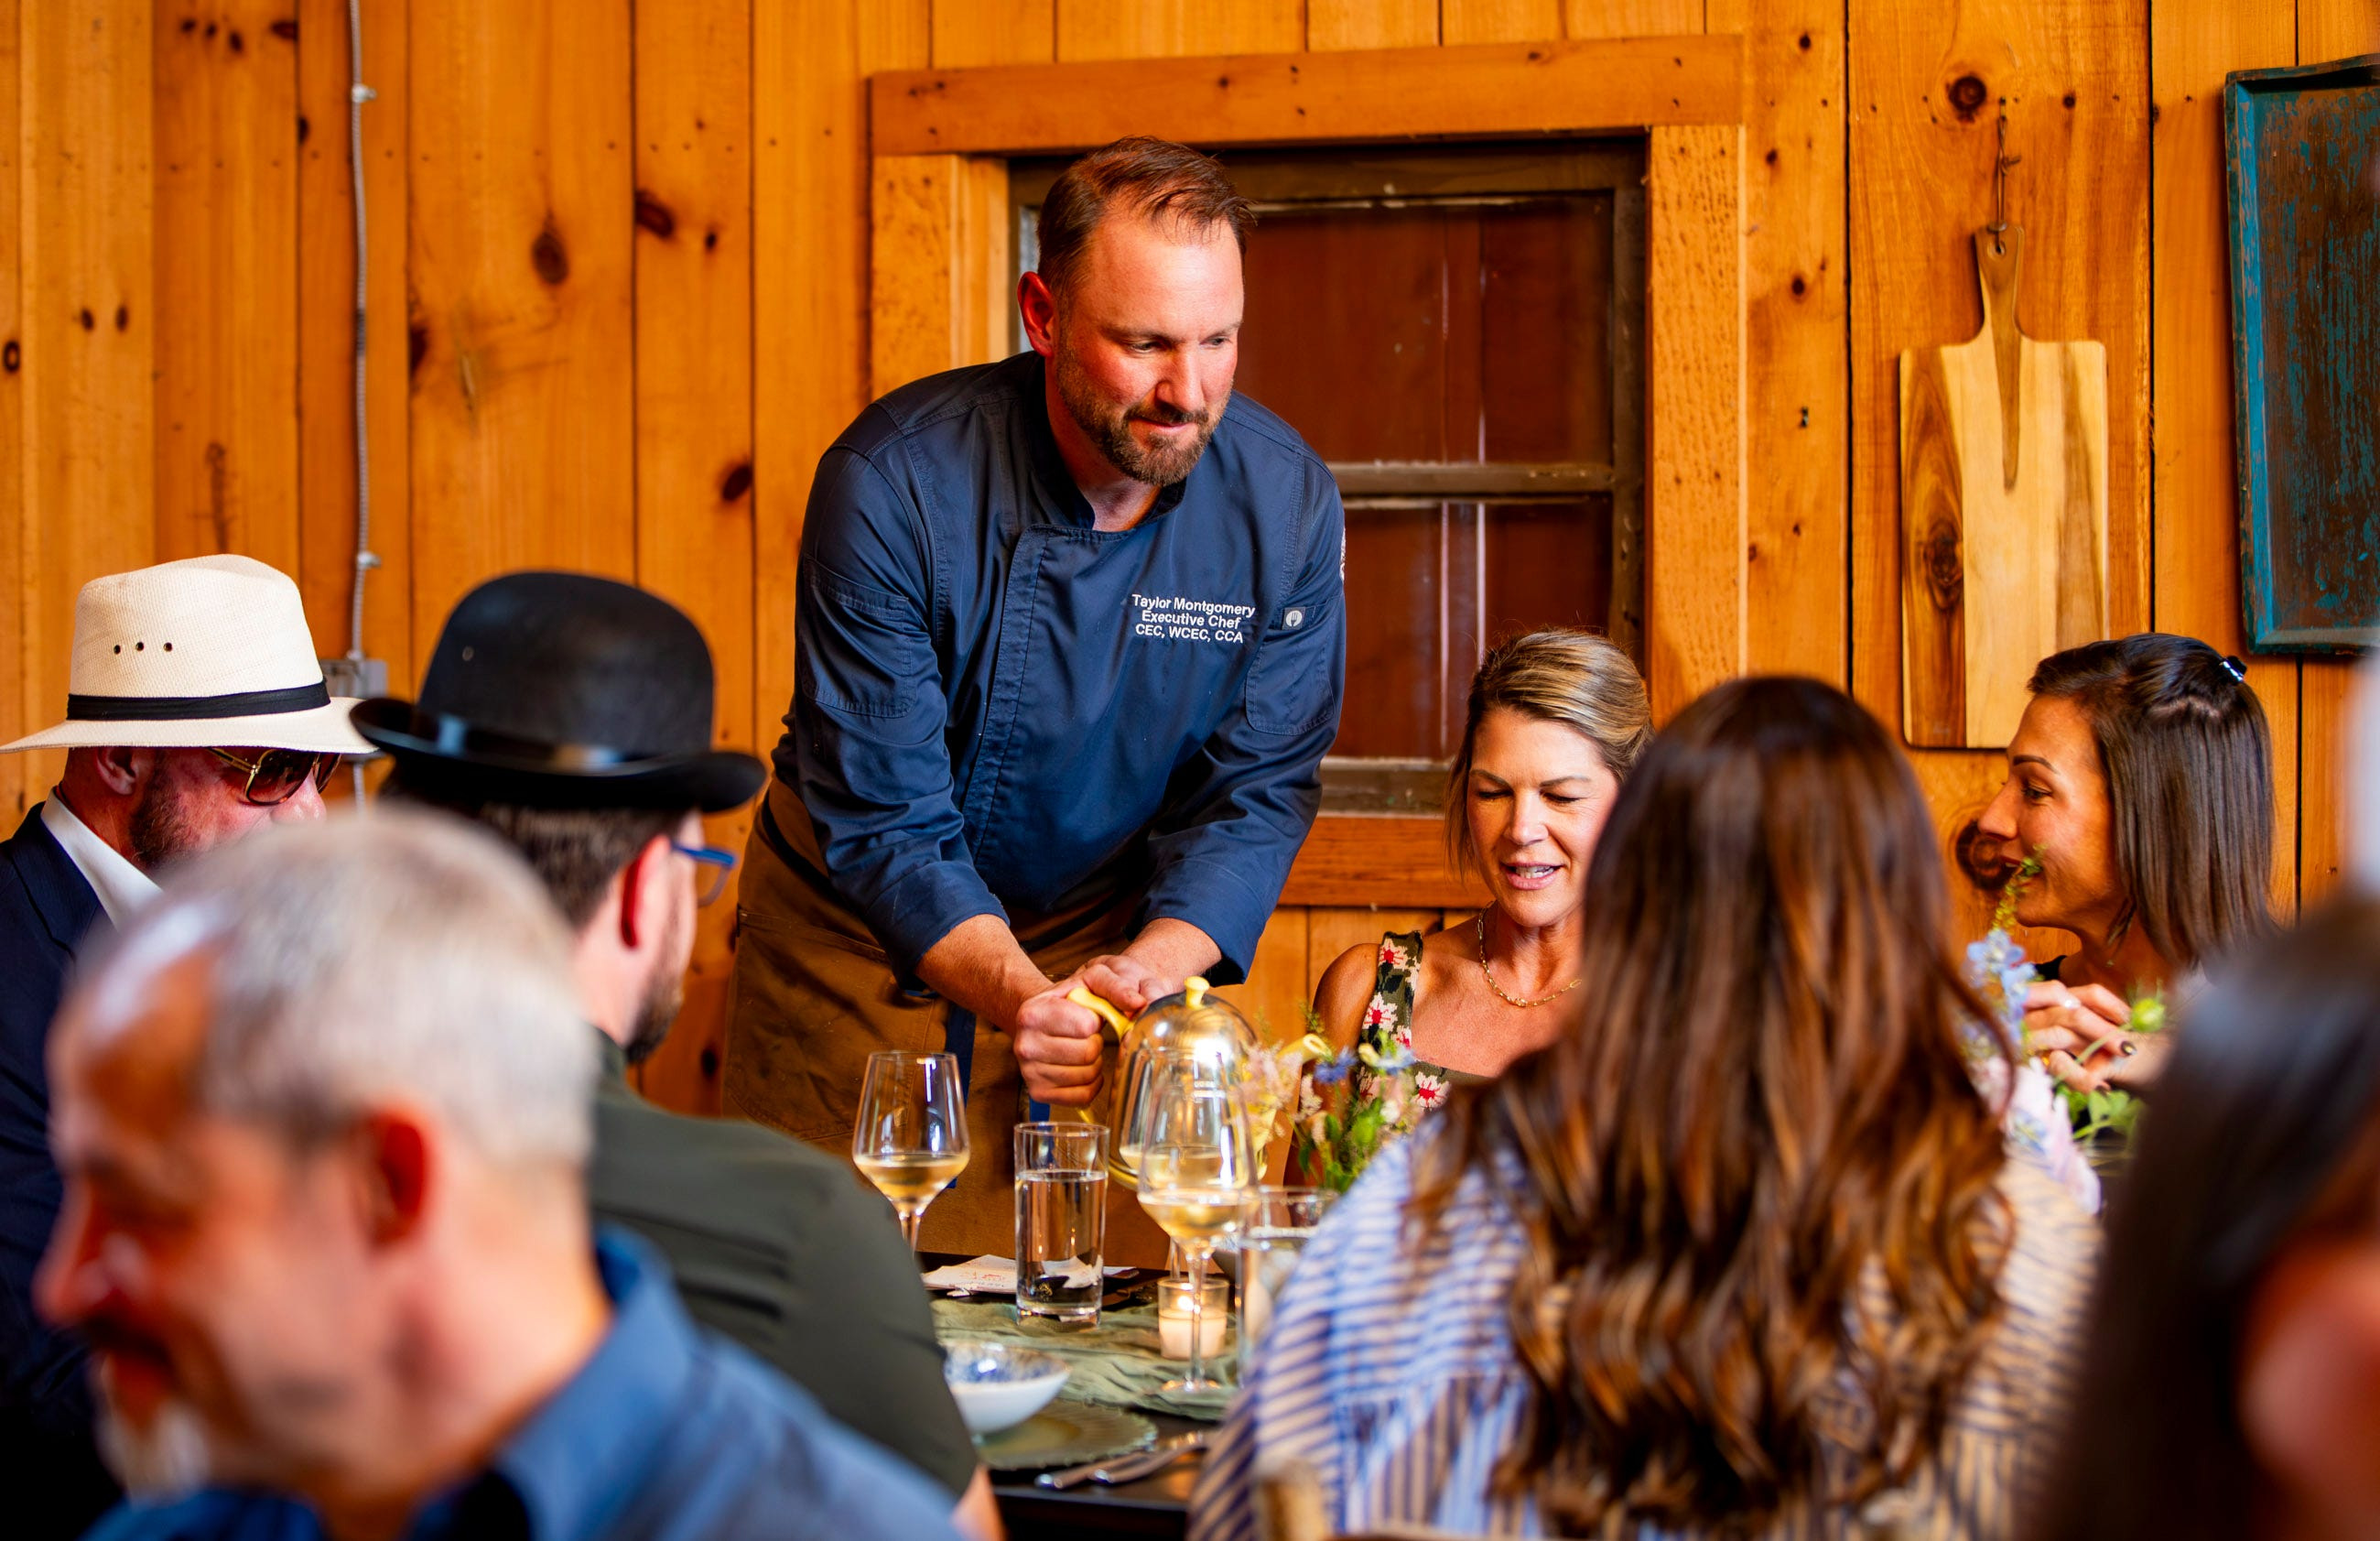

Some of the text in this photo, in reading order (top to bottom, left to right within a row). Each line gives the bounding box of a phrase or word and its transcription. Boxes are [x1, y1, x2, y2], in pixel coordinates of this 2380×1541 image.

[1131, 593, 1256, 618] Taylor Montgomery
[1141, 609, 1241, 630] Executive Chef
[1135, 624, 1244, 644] CEC, WCEC, CCA
